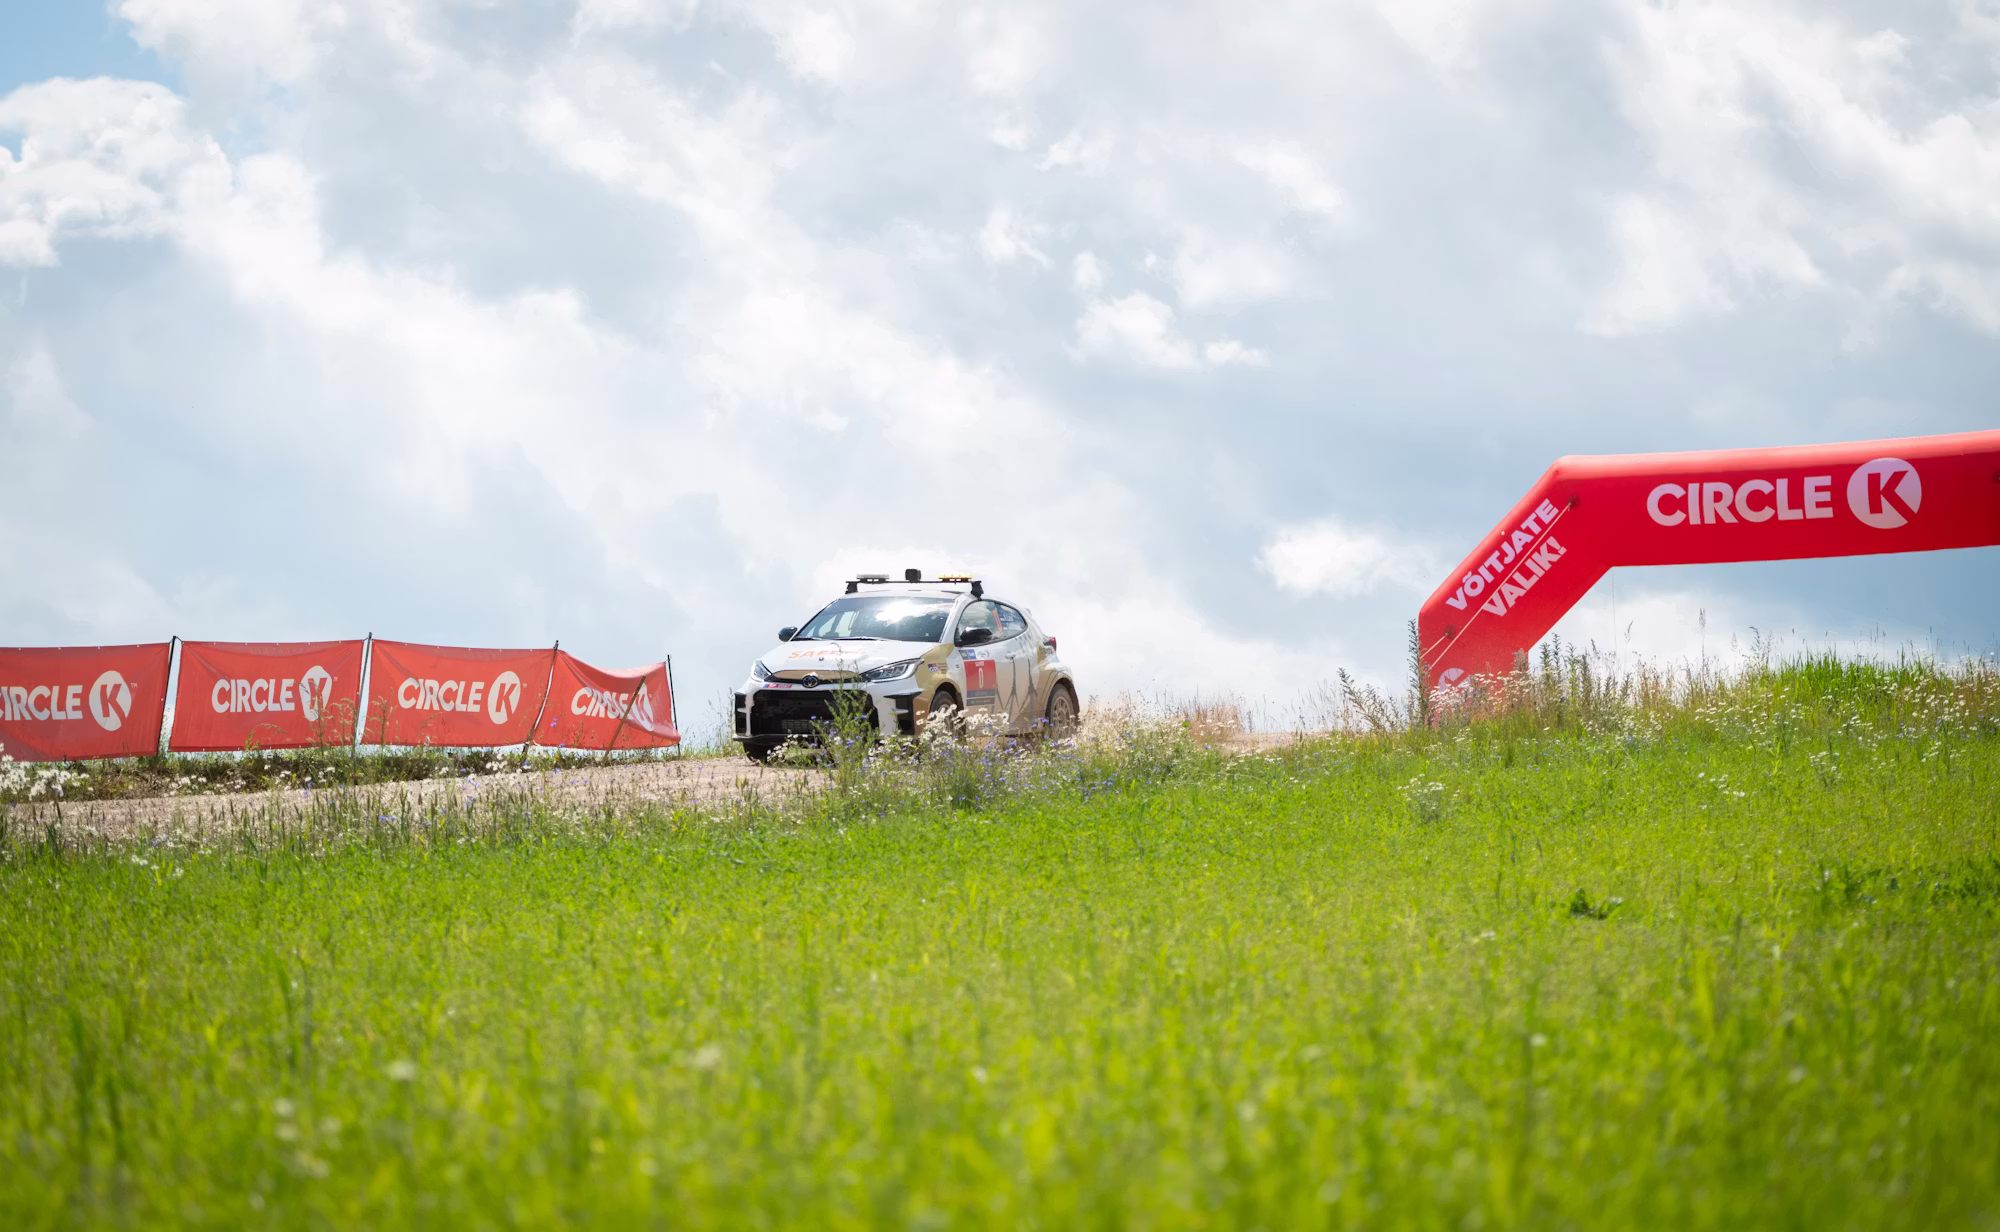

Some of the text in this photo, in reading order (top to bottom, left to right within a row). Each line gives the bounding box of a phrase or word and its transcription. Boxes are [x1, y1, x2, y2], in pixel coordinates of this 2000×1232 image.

[1647, 470, 1917, 526] CIRCLE K
[1446, 498, 1559, 610] VÕITJATE
[1482, 536, 1567, 616] VALIK!
[211, 678, 295, 713] CIRCLE
[398, 677, 484, 712] CIRCLE
[978, 667, 984, 689] 0
[0, 685, 83, 720] IRCLE
